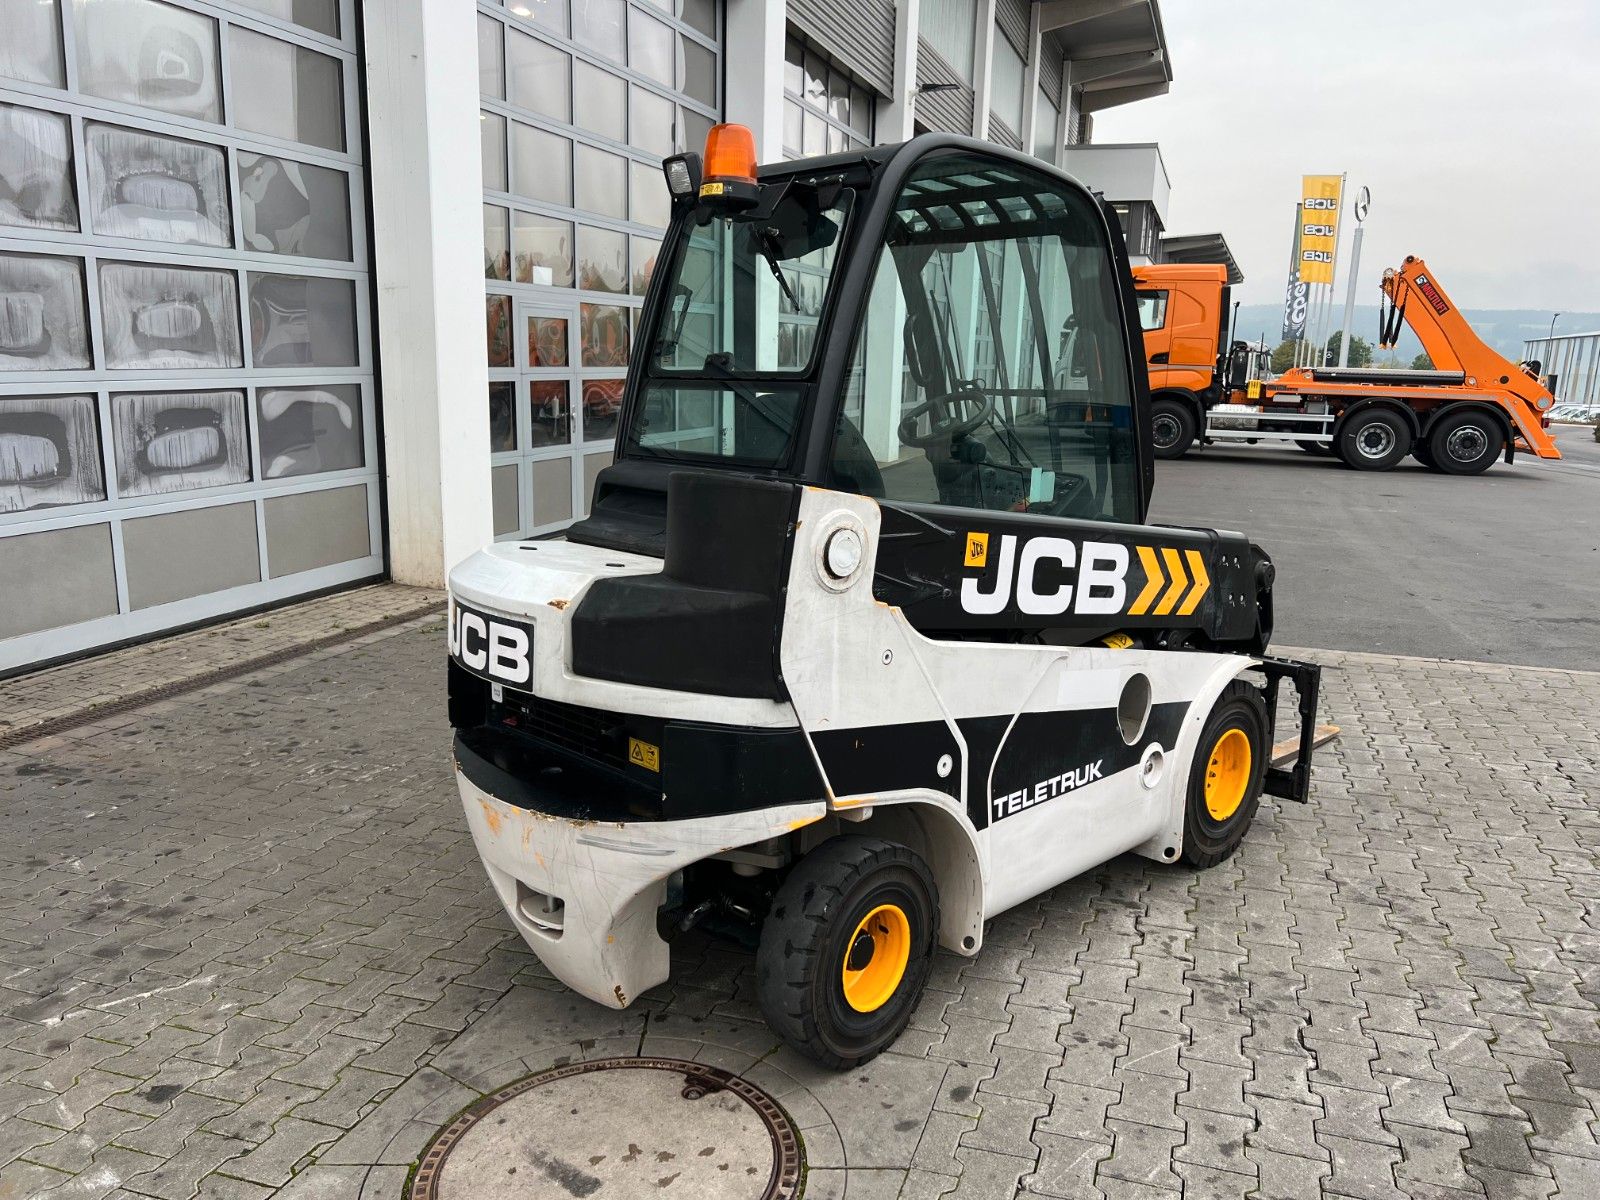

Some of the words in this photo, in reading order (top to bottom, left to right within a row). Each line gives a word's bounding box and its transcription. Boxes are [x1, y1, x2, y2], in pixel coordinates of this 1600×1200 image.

[1421, 282, 1448, 314] MULTILIFT
[960, 534, 1130, 615] JCB
[970, 541, 985, 558] JCB
[452, 606, 530, 684] JCB
[993, 759, 1103, 818] TELETRUK
